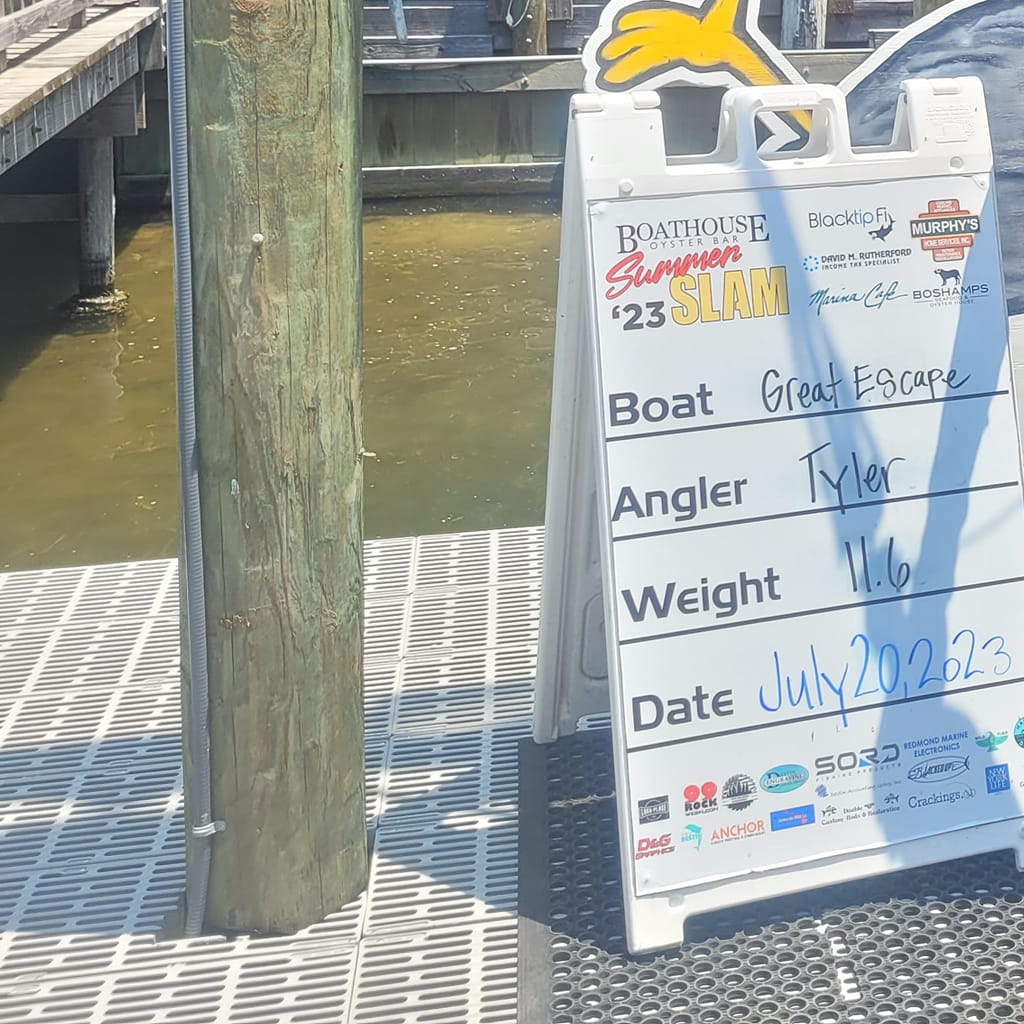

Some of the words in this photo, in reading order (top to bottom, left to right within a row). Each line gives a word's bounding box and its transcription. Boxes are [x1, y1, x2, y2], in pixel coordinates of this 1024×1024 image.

[616, 214, 770, 254] BOATHOUSE
[911, 218, 979, 236] MURPHY'S
[650, 238, 704, 250] OYSTER
[712, 235, 739, 245] BAR
[821, 254, 846, 264] DAVID
[848, 253, 858, 261] M.
[859, 248, 912, 260] RUTHERFORD
[822, 263, 847, 271] INCOME
[864, 258, 900, 267] SPECIALIST
[605, 244, 743, 300] Summer
[669, 266, 790, 326] SLAM
[808, 287, 866, 316] Marina
[912, 284, 989, 300] BOSHAMPS
[761, 362, 843, 413] Great
[608, 383, 714, 427] Boat
[798, 442, 906, 515] Tyler
[611, 475, 749, 523] Angler
[844, 536, 911, 593] 11.6
[621, 567, 782, 623] Weight
[758, 643, 849, 728] July
[631, 684, 734, 732] Date
[903, 736, 940, 750] REDMOND
[941, 731, 969, 743] MARINE
[914, 742, 960, 757] ELECTRONICS
[683, 781, 718, 803] 99
[990, 780, 1007, 789] LIFE
[684, 798, 718, 812] ROCK
[637, 833, 672, 852] D&G
[710, 819, 765, 842] ANCHOR
